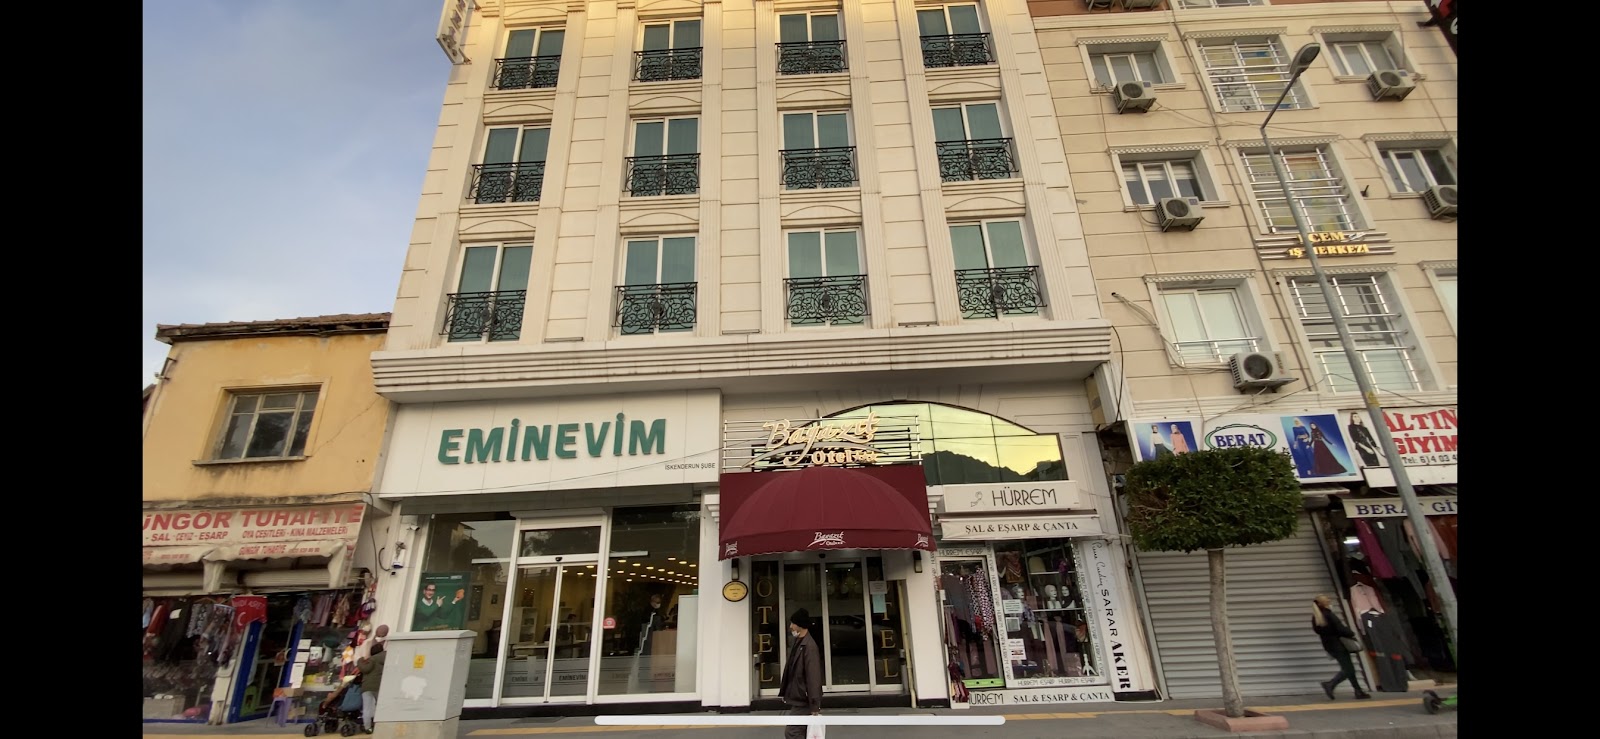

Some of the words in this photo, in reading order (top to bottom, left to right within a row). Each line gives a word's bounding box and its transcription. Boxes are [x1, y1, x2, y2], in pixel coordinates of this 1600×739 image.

[437, 412, 666, 465] EMİNEVİM
[1214, 433, 1266, 447] BERAT
[811, 450, 851, 465] Otel
[992, 487, 1057, 507] HÜRREM
[965, 525, 985, 534] ŞAL
[987, 524, 995, 532] &
[998, 524, 1030, 533] EŞARP
[1033, 523, 1040, 531] &
[1043, 522, 1078, 532] ÇANTA
[756, 579, 774, 683] OTEL
[1101, 588, 1118, 637] SARAR
[1110, 639, 1131, 690] AKER
[1032, 694, 1039, 702] &
[1071, 693, 1079, 701] &
[1080, 692, 1110, 702] ÇANTA
